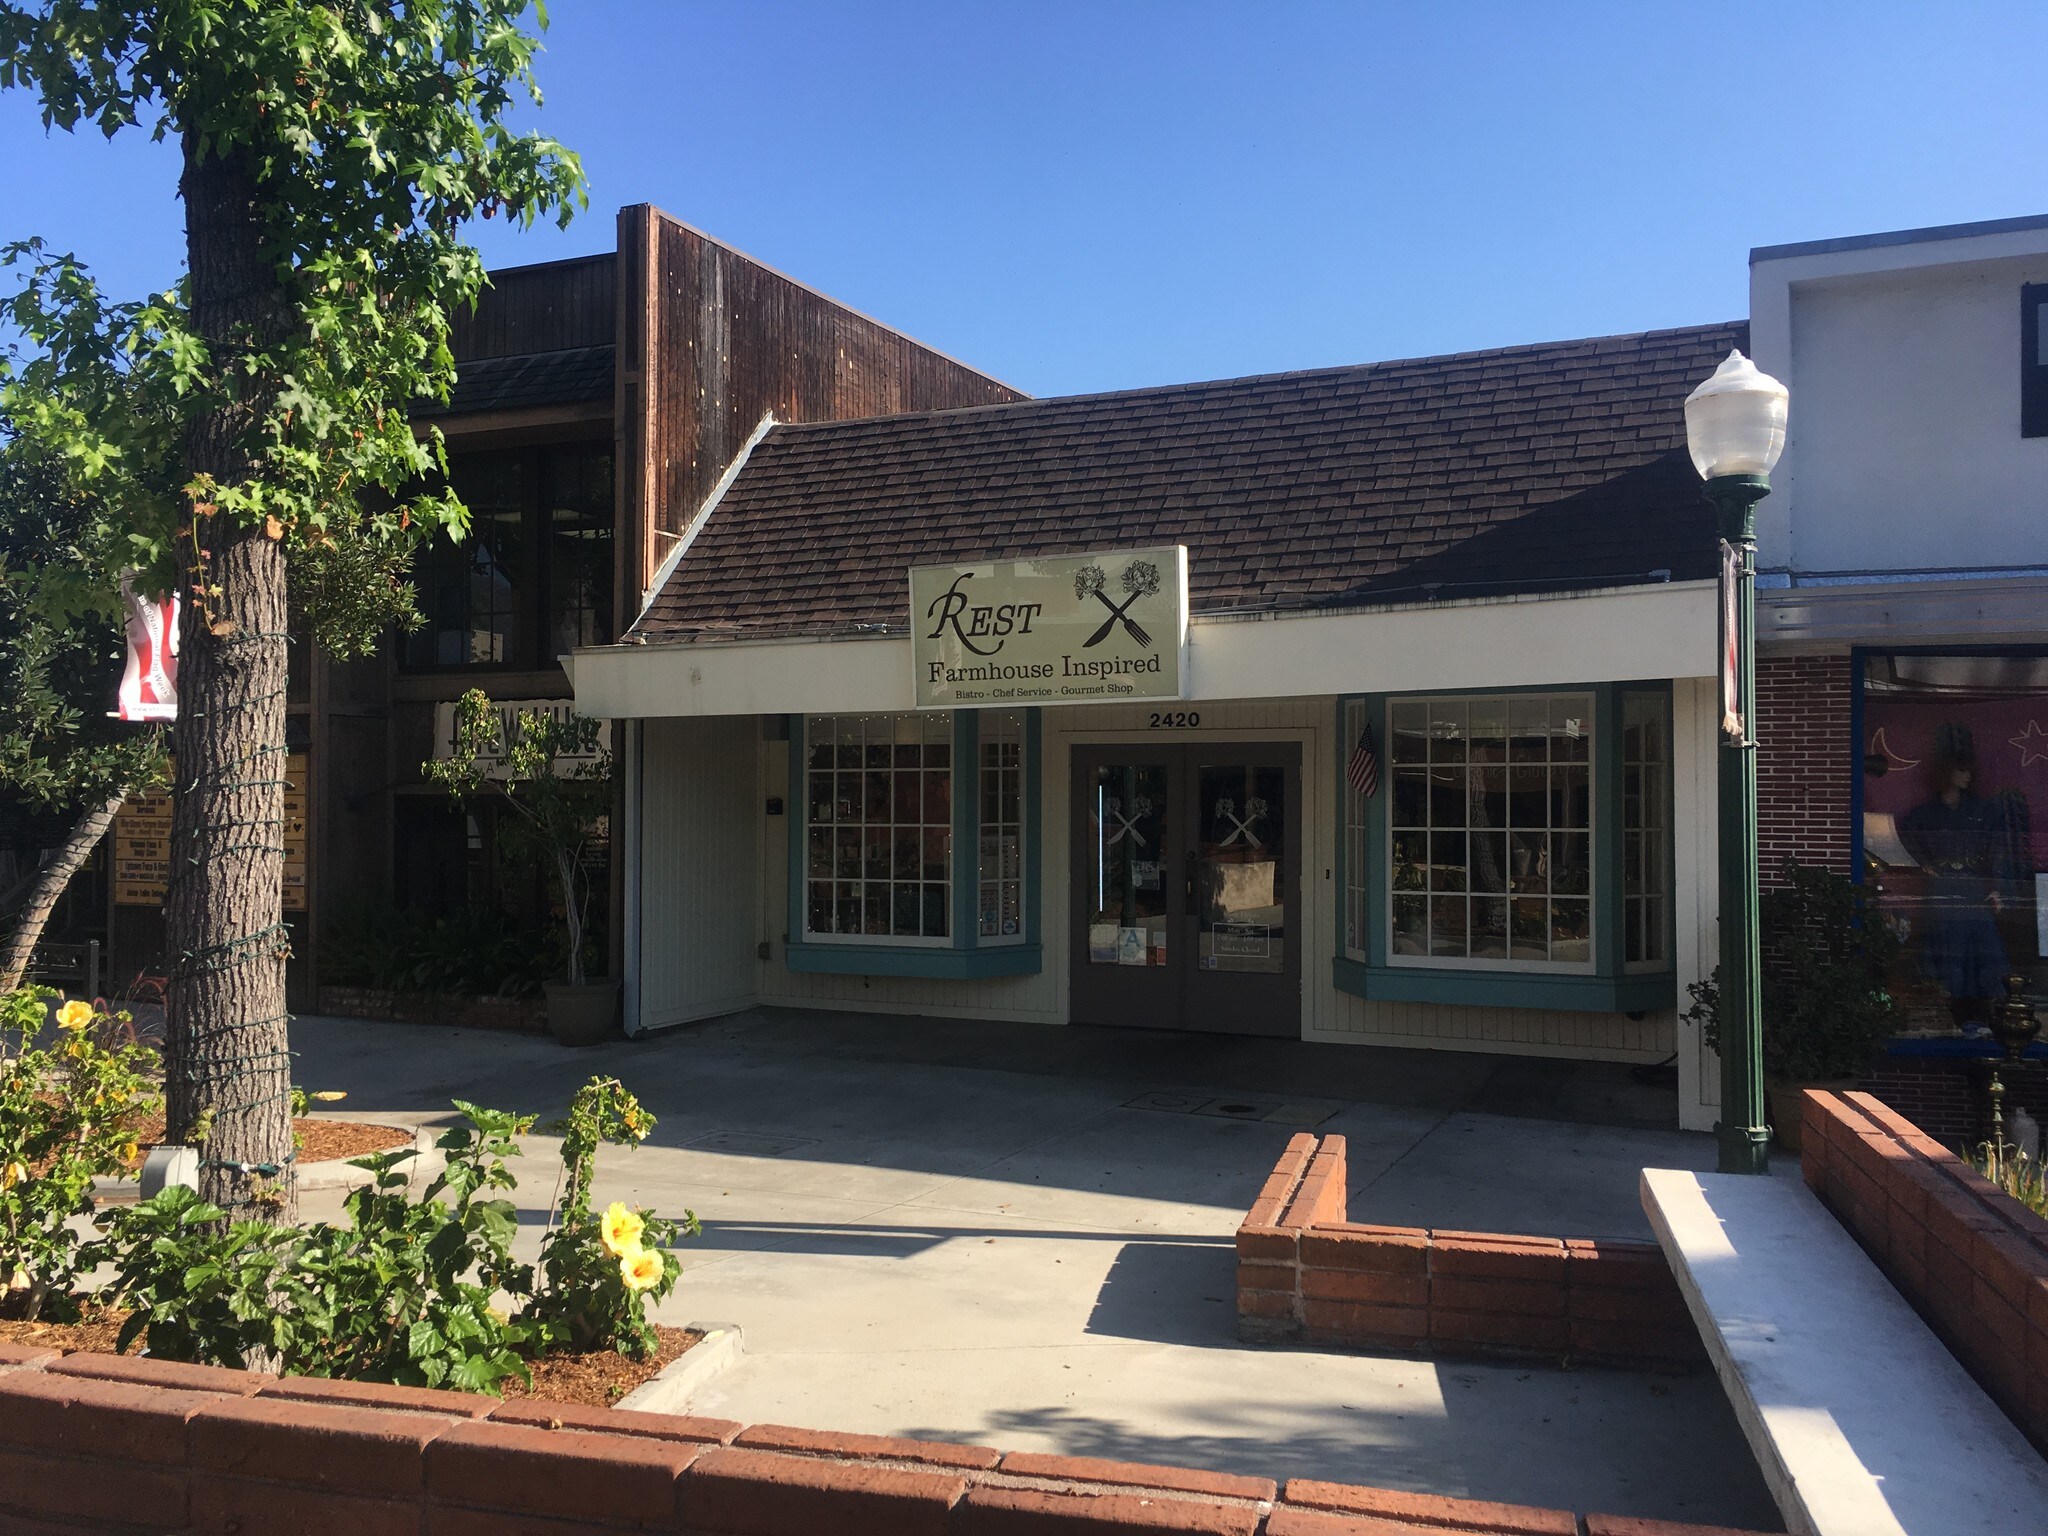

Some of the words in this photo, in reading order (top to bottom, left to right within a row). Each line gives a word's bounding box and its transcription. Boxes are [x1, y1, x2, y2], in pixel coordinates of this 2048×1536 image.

[928, 662, 1054, 683] Farmhouse
[1061, 654, 1161, 681] Inspired
[955, 689, 985, 699] Bistro
[992, 688, 1015, 698] Chef
[1017, 686, 1053, 697] Service
[1060, 684, 1105, 695] Gourmet
[1107, 683, 1133, 695] Shop
[1150, 711, 1200, 728] 2420
[1125, 929, 1140, 947] A
